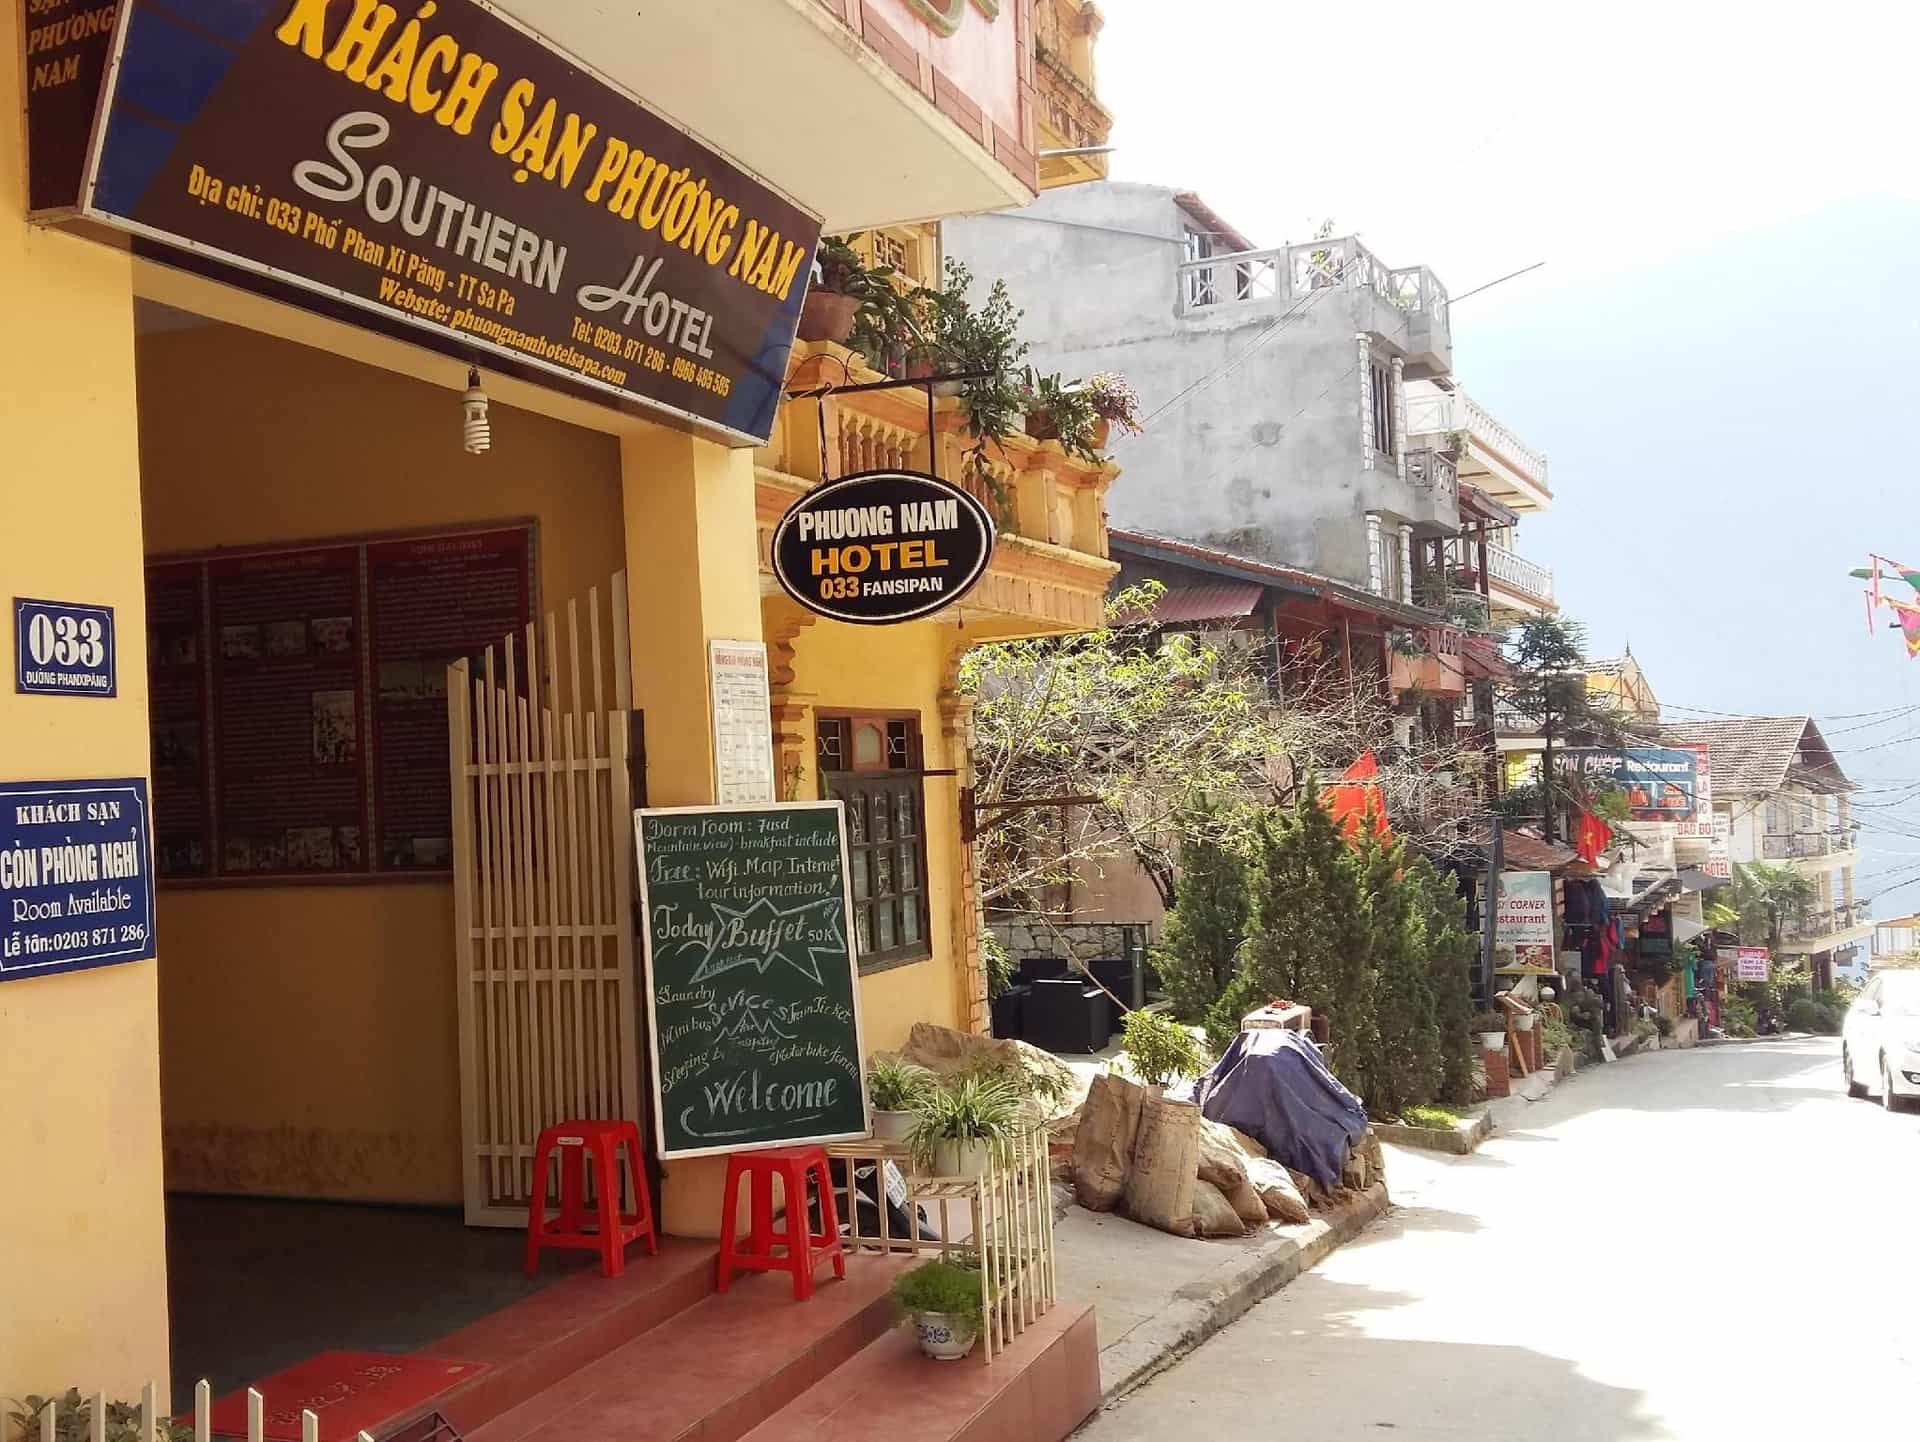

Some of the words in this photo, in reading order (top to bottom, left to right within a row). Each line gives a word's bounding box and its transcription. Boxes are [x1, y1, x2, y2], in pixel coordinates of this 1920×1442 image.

[32, 54, 80, 91] NAM
[275, 0, 499, 137] KHÁCH
[490, 78, 597, 190] SẠN
[584, 136, 740, 266] PHƯƠNG
[728, 218, 806, 301] NAM
[188, 165, 223, 211] Địa
[225, 184, 264, 220] chỉ:
[265, 202, 301, 235] 033
[303, 213, 344, 249] Phố
[342, 228, 384, 267] Phan
[386, 245, 406, 275] Xi
[406, 253, 446, 294] Păng
[458, 273, 478, 302] TT
[477, 281, 496, 309] Sa
[496, 288, 516, 317] Pa
[379, 277, 451, 322] Website:
[449, 306, 628, 386] phuongnamhotelsapa.com
[571, 316, 593, 344] Tel:
[623, 338, 644, 364] 871
[644, 346, 666, 373] 286
[672, 356, 696, 383] 0966
[713, 373, 731, 398] 585
[799, 505, 893, 543] PHUONG
[901, 499, 959, 534] NAM
[811, 539, 949, 576] HOTEL
[820, 576, 860, 600] 033
[863, 577, 943, 598] FANSIPAN
[29, 613, 104, 668] 033
[1627, 759, 1690, 773] Restaurant
[16, 800, 81, 826] KHÁCH
[87, 802, 120, 826] SẠN
[646, 819, 697, 840] Dorm
[701, 819, 743, 837] room
[0, 840, 38, 889] CÒN
[41, 836, 98, 885] PHÒNG
[101, 827, 139, 880] NGHỈ
[740, 834, 793, 853] breakfast
[795, 830, 840, 847] include
[651, 855, 691, 882] Free
[706, 857, 738, 884] Wifi
[785, 854, 840, 874] Internet
[13, 899, 62, 922] Room
[67, 886, 132, 916] Available
[1510, 900, 1546, 910] CORNER
[4, 931, 21, 957] Lễ
[92, 927, 116, 946] 871
[121, 923, 145, 943] 286
[654, 903, 714, 951] Today
[722, 914, 808, 954] Buffet
[807, 927, 833, 942] 50K
[704, 1067, 839, 1117] Welcome
